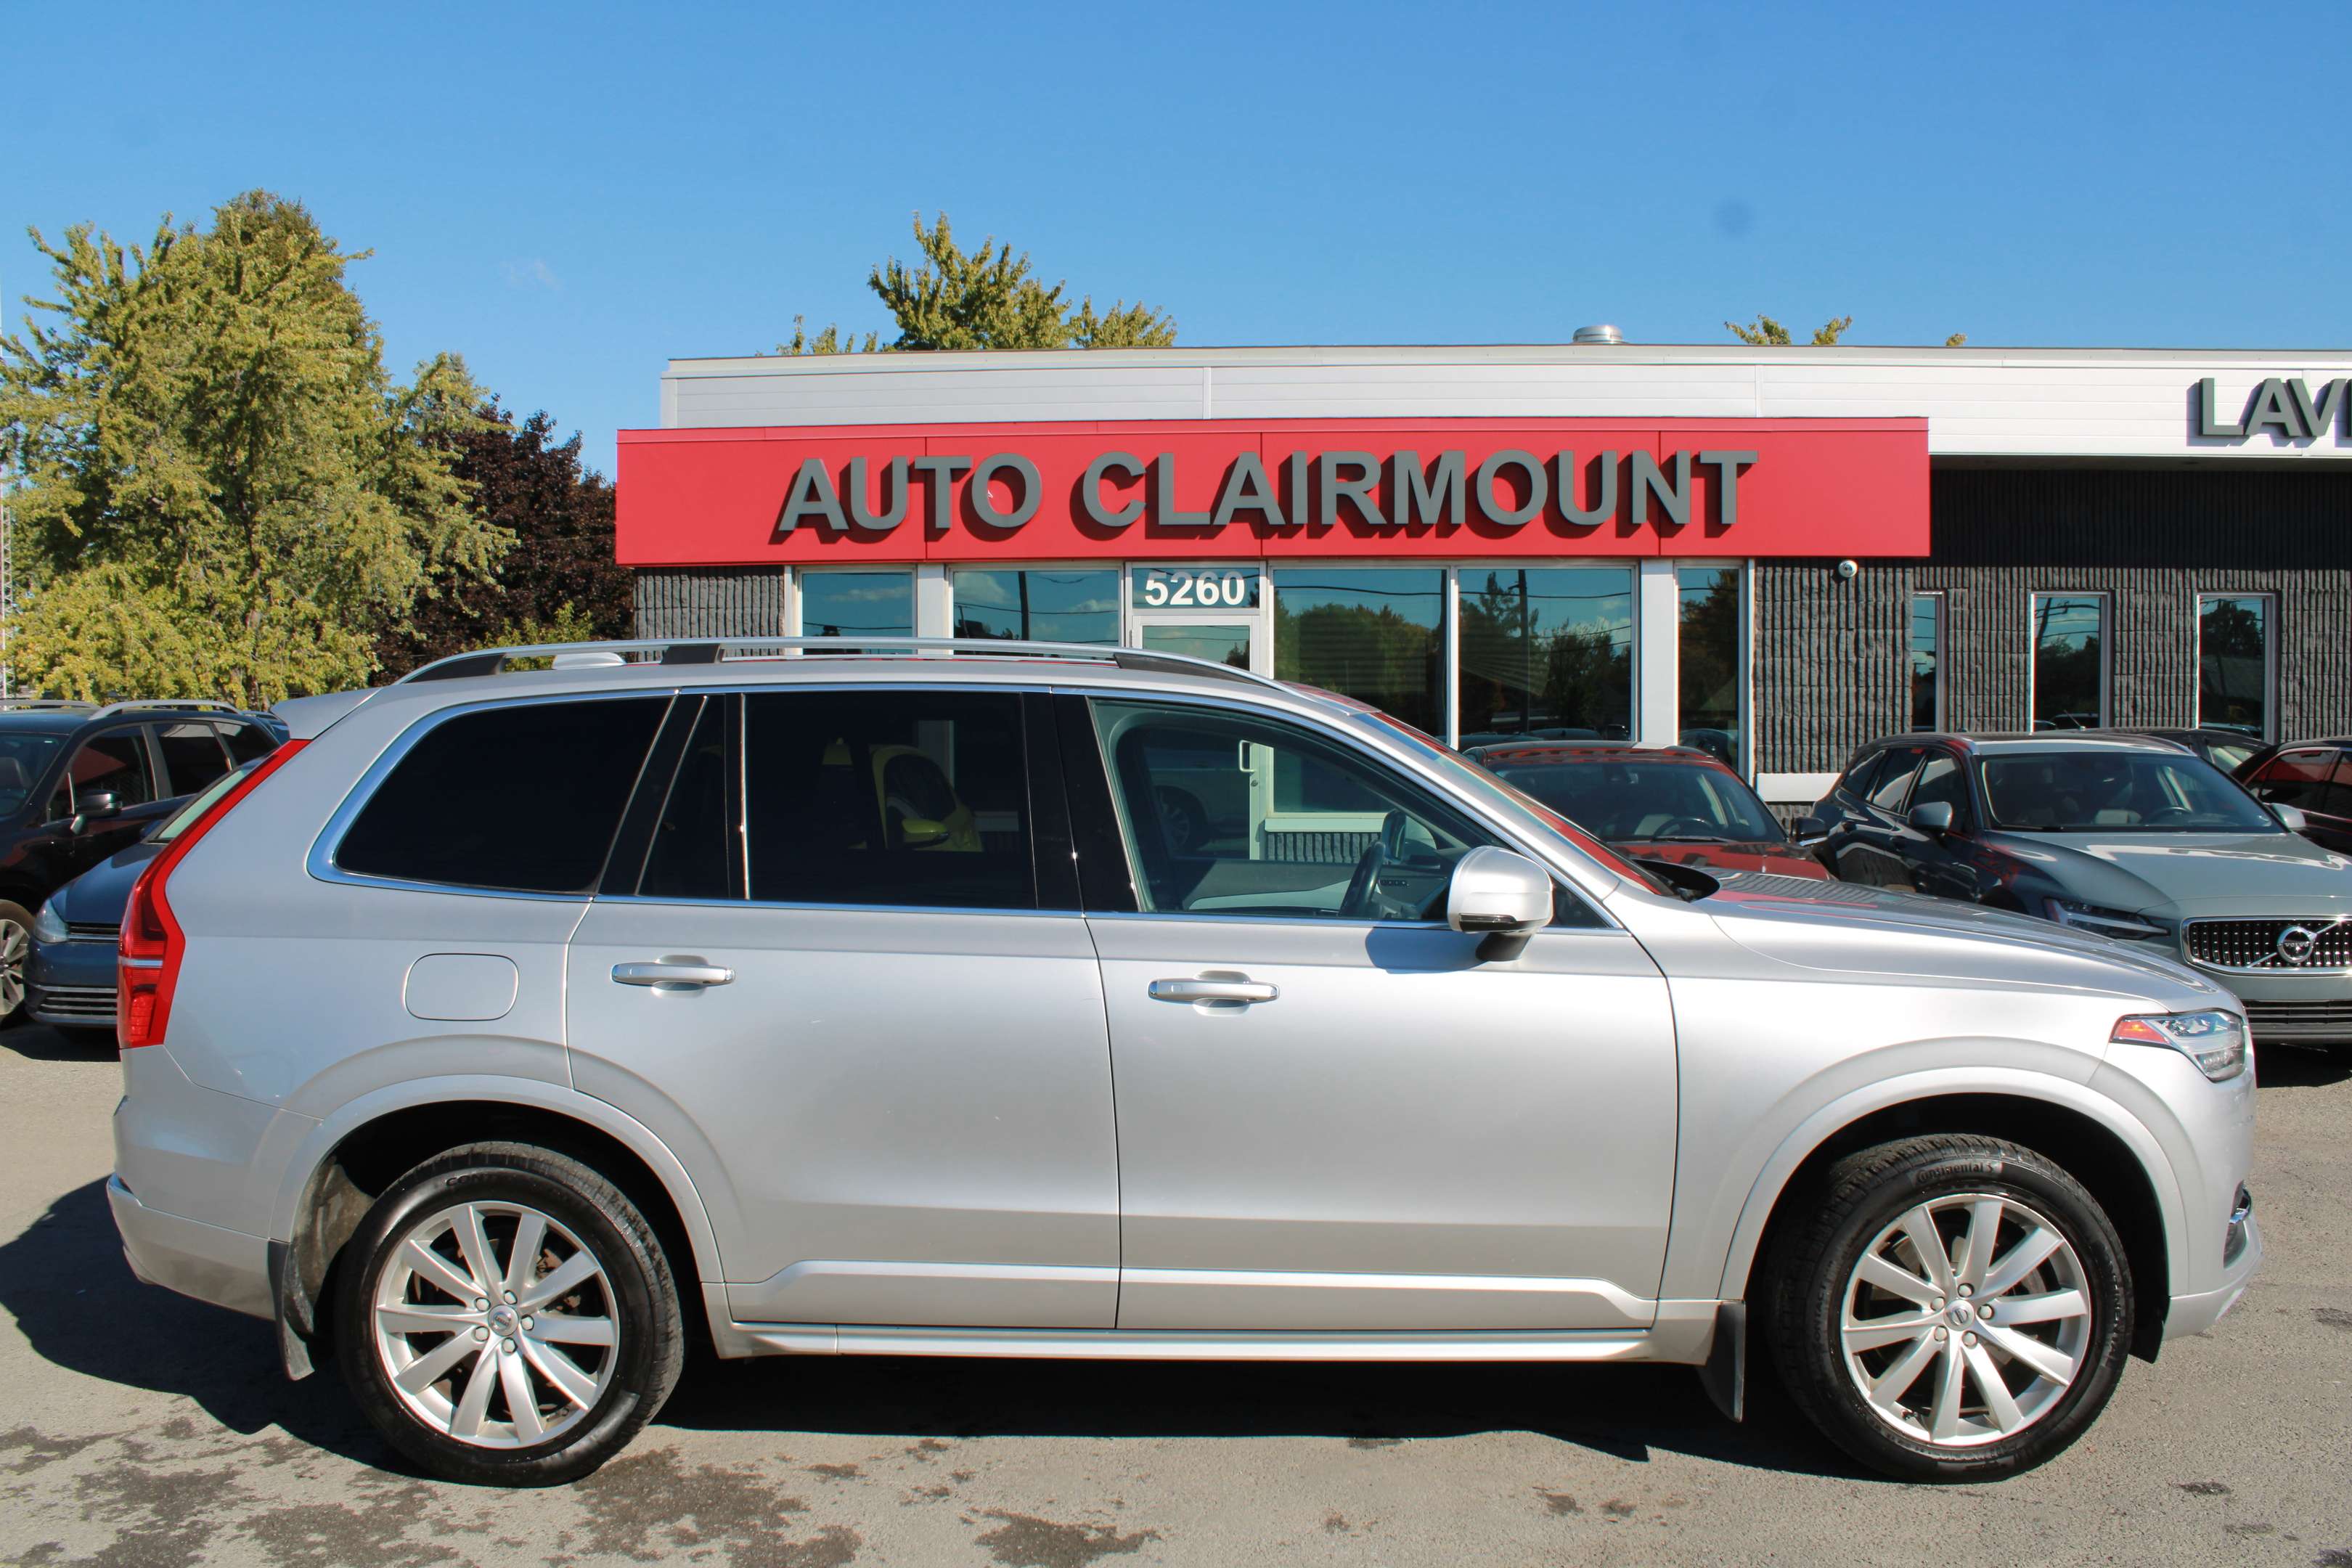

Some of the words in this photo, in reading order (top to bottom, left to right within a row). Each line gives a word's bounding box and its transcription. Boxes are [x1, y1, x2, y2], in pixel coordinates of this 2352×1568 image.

[2202, 377, 2352, 436] LAV
[779, 452, 1042, 531] AUTO
[1082, 450, 1760, 528] CLAIRMOUNT
[1145, 571, 1245, 605] 5260
